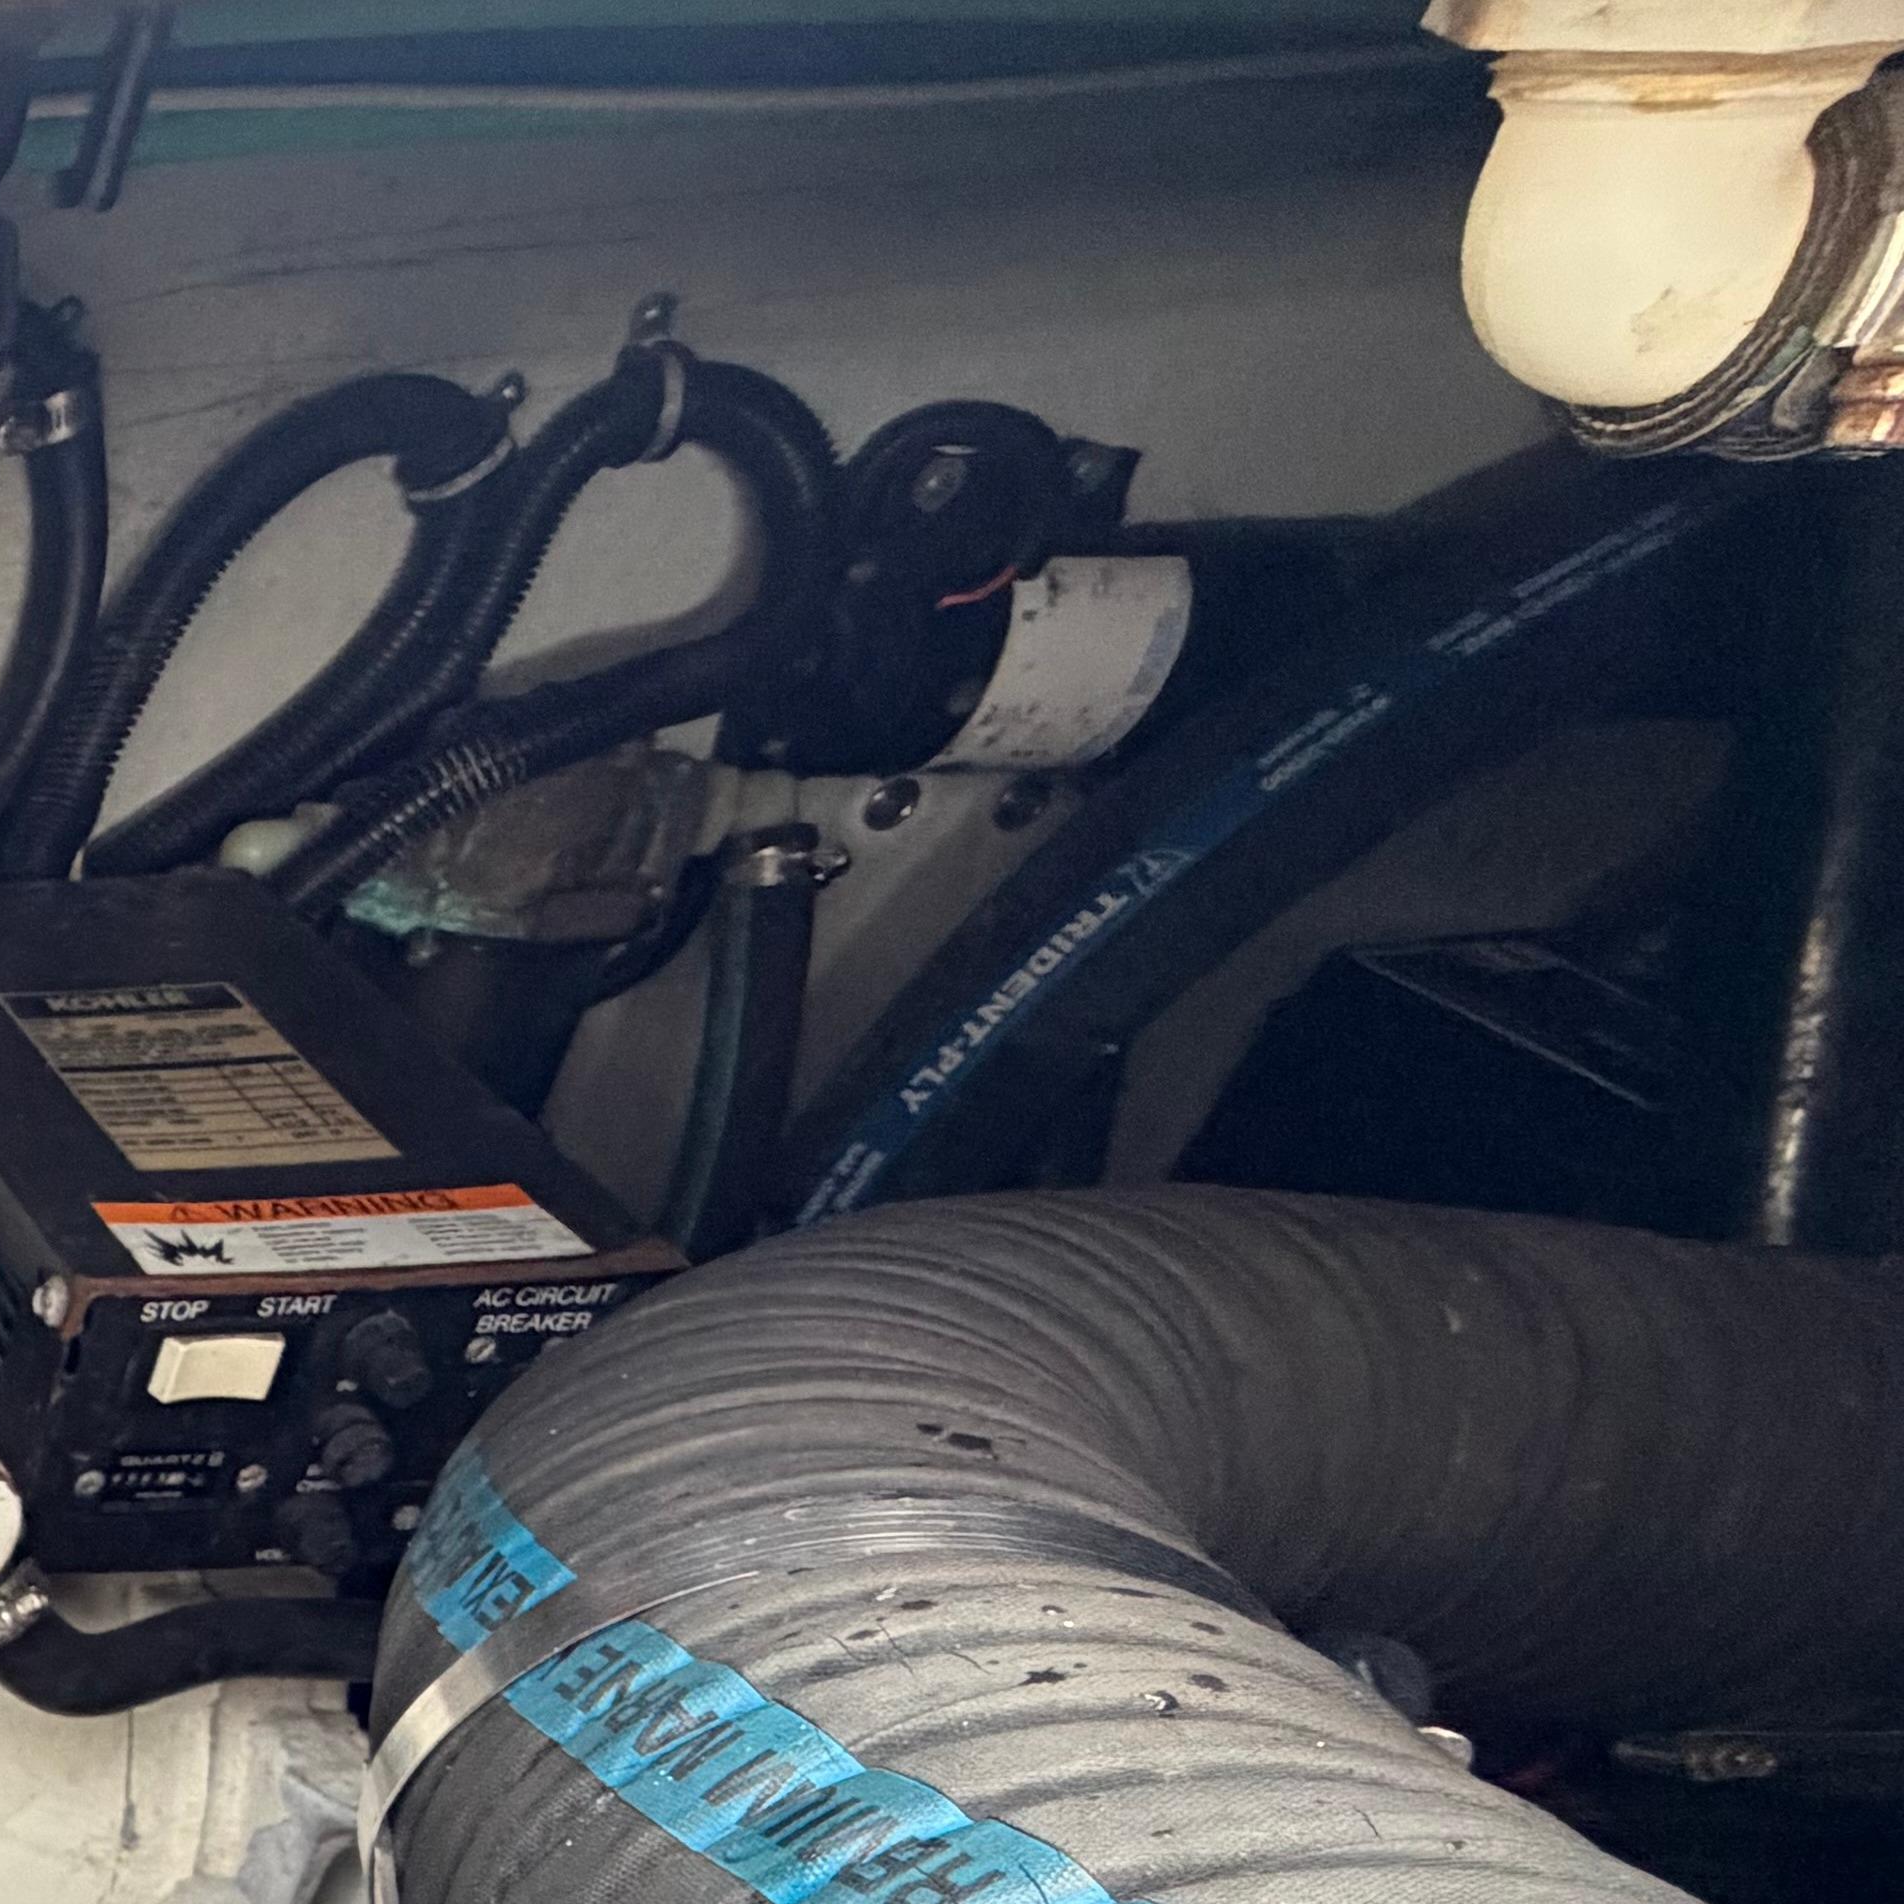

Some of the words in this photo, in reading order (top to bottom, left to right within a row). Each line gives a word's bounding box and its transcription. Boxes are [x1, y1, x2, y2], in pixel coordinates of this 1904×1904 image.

[899, 892, 1129, 1118] TRIDENT-PLY
[213, 1189, 460, 1221] WARNING
[140, 1300, 211, 1323] STOP
[257, 1294, 338, 1317] START
[473, 1287, 518, 1310] AC
[515, 1281, 620, 1307] CIRCUIT
[474, 1311, 593, 1334] BREAKER
[551, 1640, 747, 1784] MARNE
